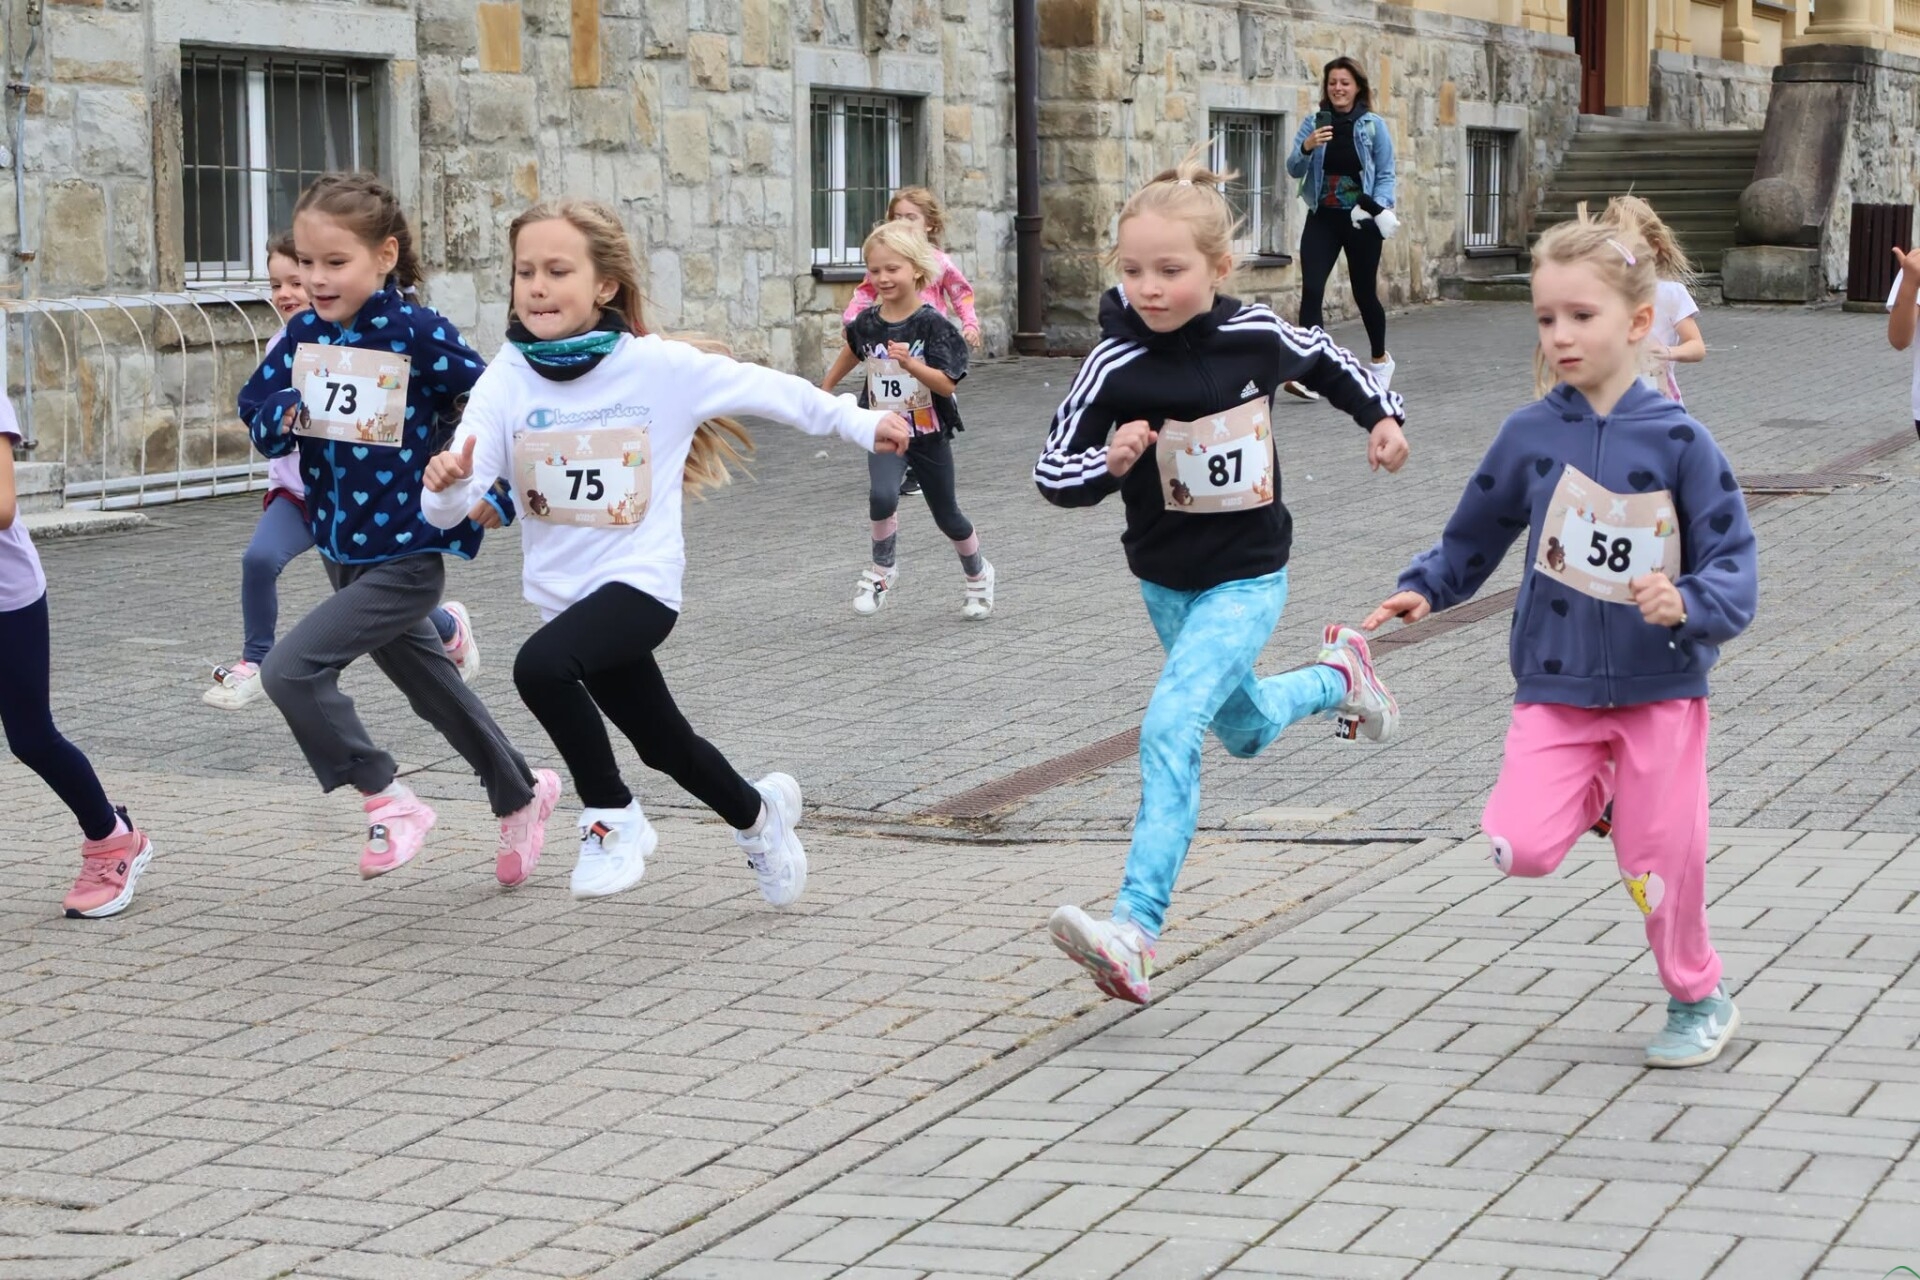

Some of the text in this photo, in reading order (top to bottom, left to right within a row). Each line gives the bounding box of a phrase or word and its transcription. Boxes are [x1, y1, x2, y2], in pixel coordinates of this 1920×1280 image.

[324, 381, 358, 415] 73
[881, 379, 902, 398] 78
[526, 403, 650, 429] Champion
[1208, 448, 1243, 487] 87
[565, 468, 605, 501] 75
[1586, 530, 1633, 573] 58
